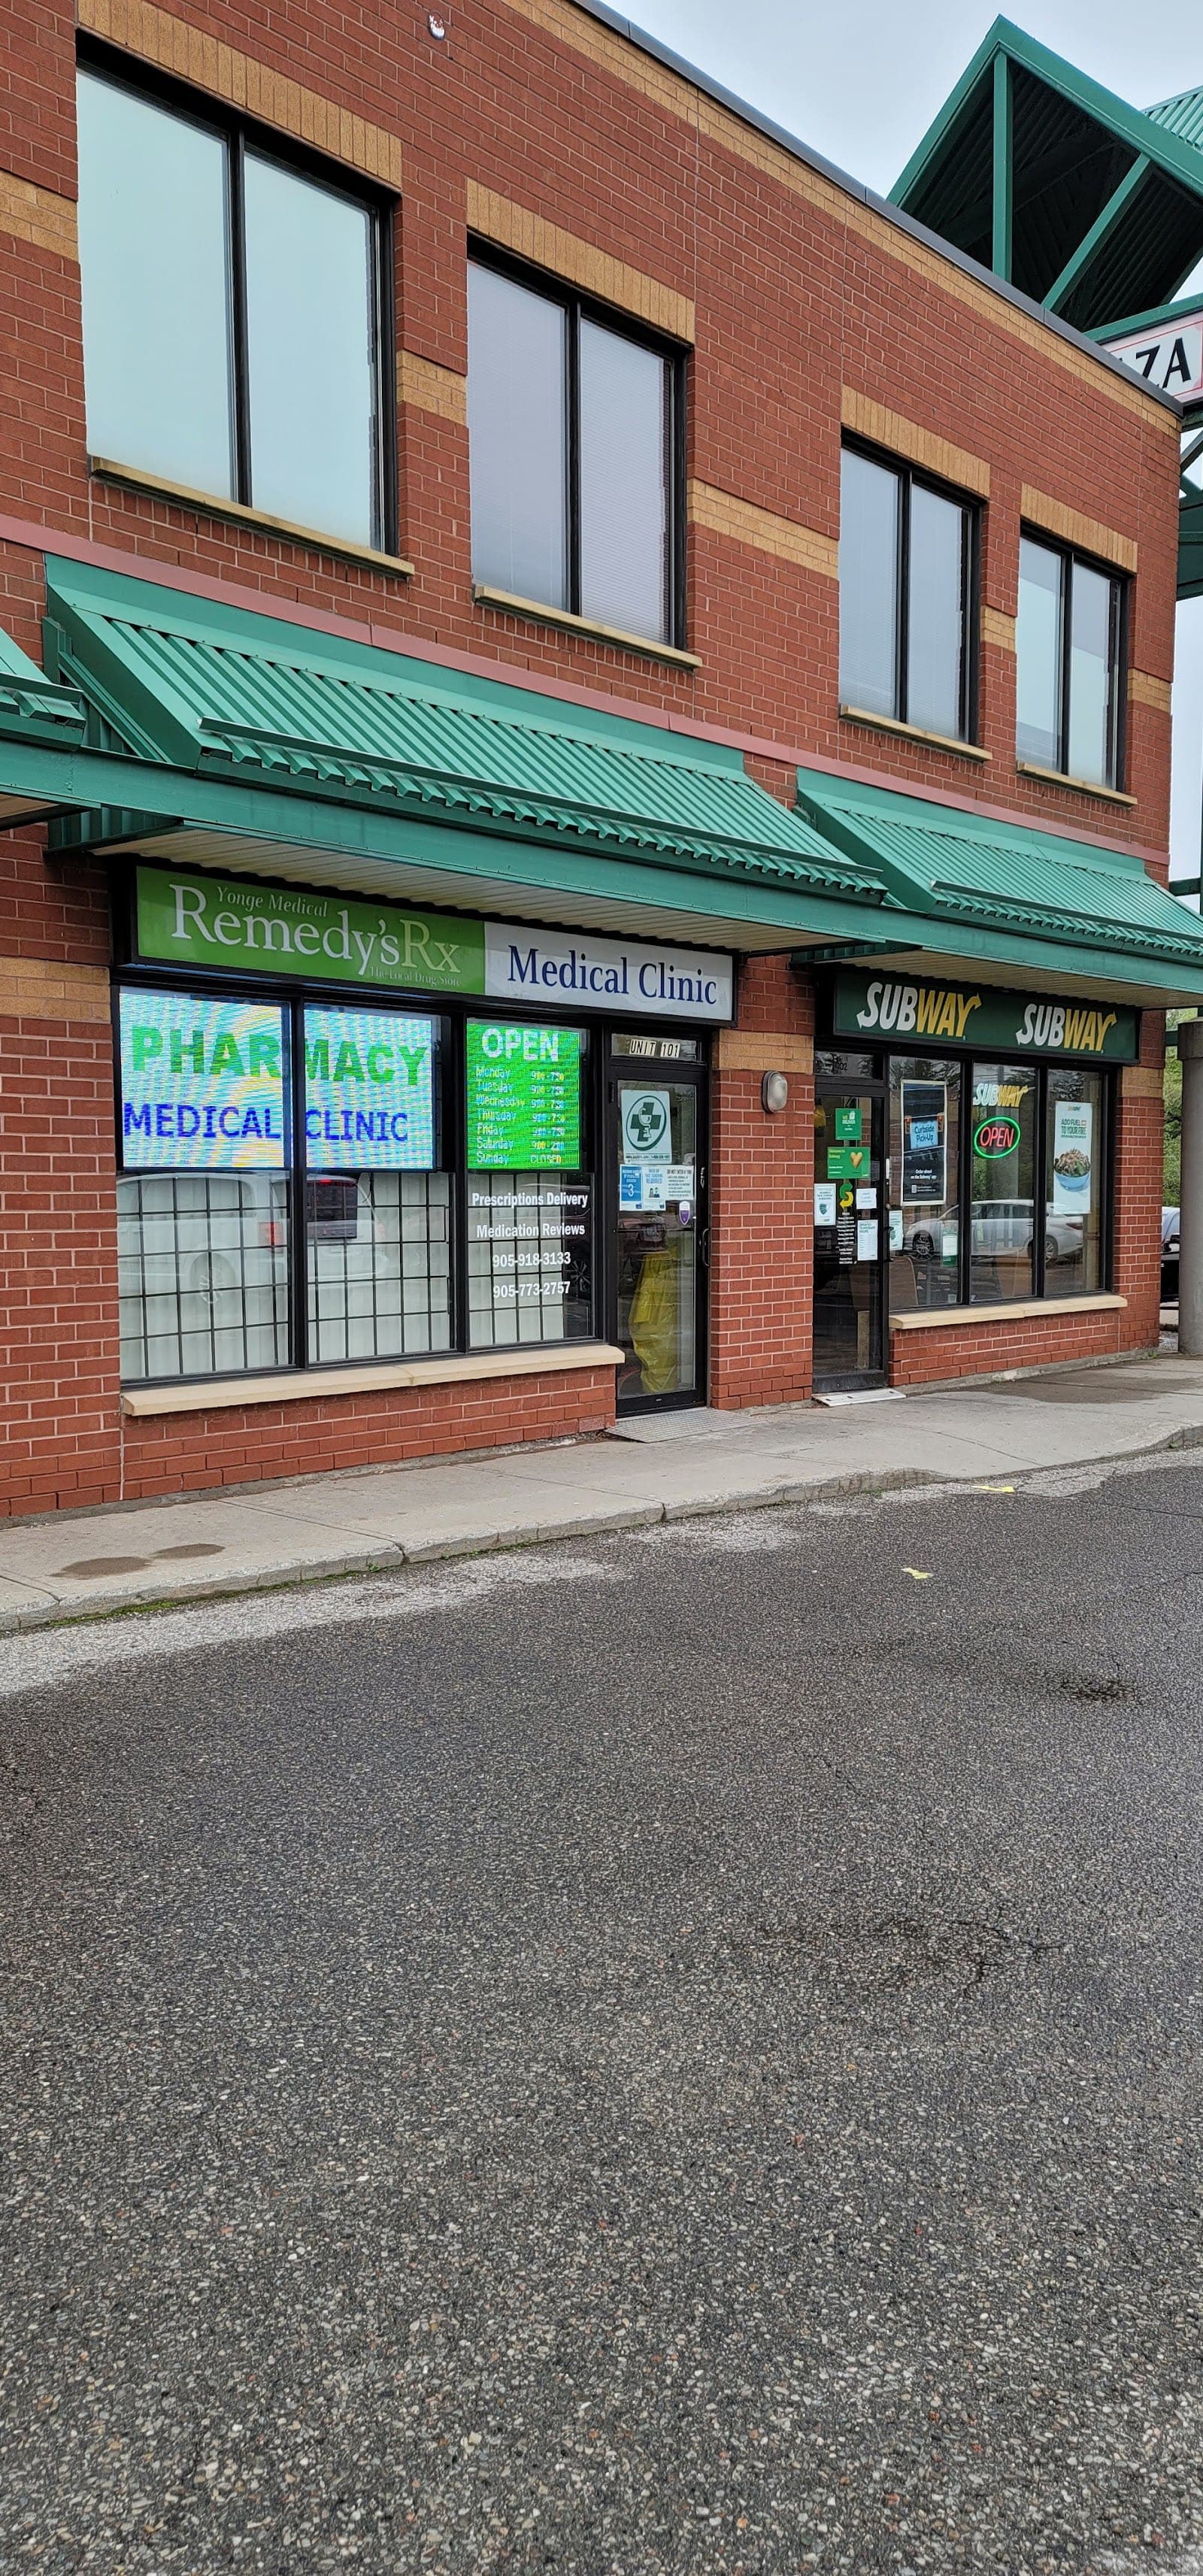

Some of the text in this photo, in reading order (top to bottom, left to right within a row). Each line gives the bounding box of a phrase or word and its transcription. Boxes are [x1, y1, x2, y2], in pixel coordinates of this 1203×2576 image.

[1119, 337, 1192, 389] ZA
[217, 886, 328, 917] Yonge Medical
[415, 972, 436, 986] Drug
[440, 975, 460, 986] Store
[508, 944, 717, 1005] Medical Clinic
[856, 982, 982, 1038] SUBWAY
[1015, 1003, 1117, 1052] SUBWAY
[481, 1027, 559, 1062] OPEN
[630, 1039, 680, 1057] UNIT 101
[972, 1083, 1029, 1108] SUBWAY
[123, 1102, 408, 1142] MEDICAL CLINIC
[914, 1125, 935, 1134] Curbside
[916, 1133, 934, 1143] Pick-Up
[979, 1127, 1015, 1148] OPEN
[472, 1192, 588, 1208] Prescriptions Delivery
[628, 1183, 635, 1197] 3
[477, 1223, 585, 1238] Medication Reviews
[492, 1252, 571, 1268] 905-918-3133
[493, 1280, 571, 1299] 905-773-2757
